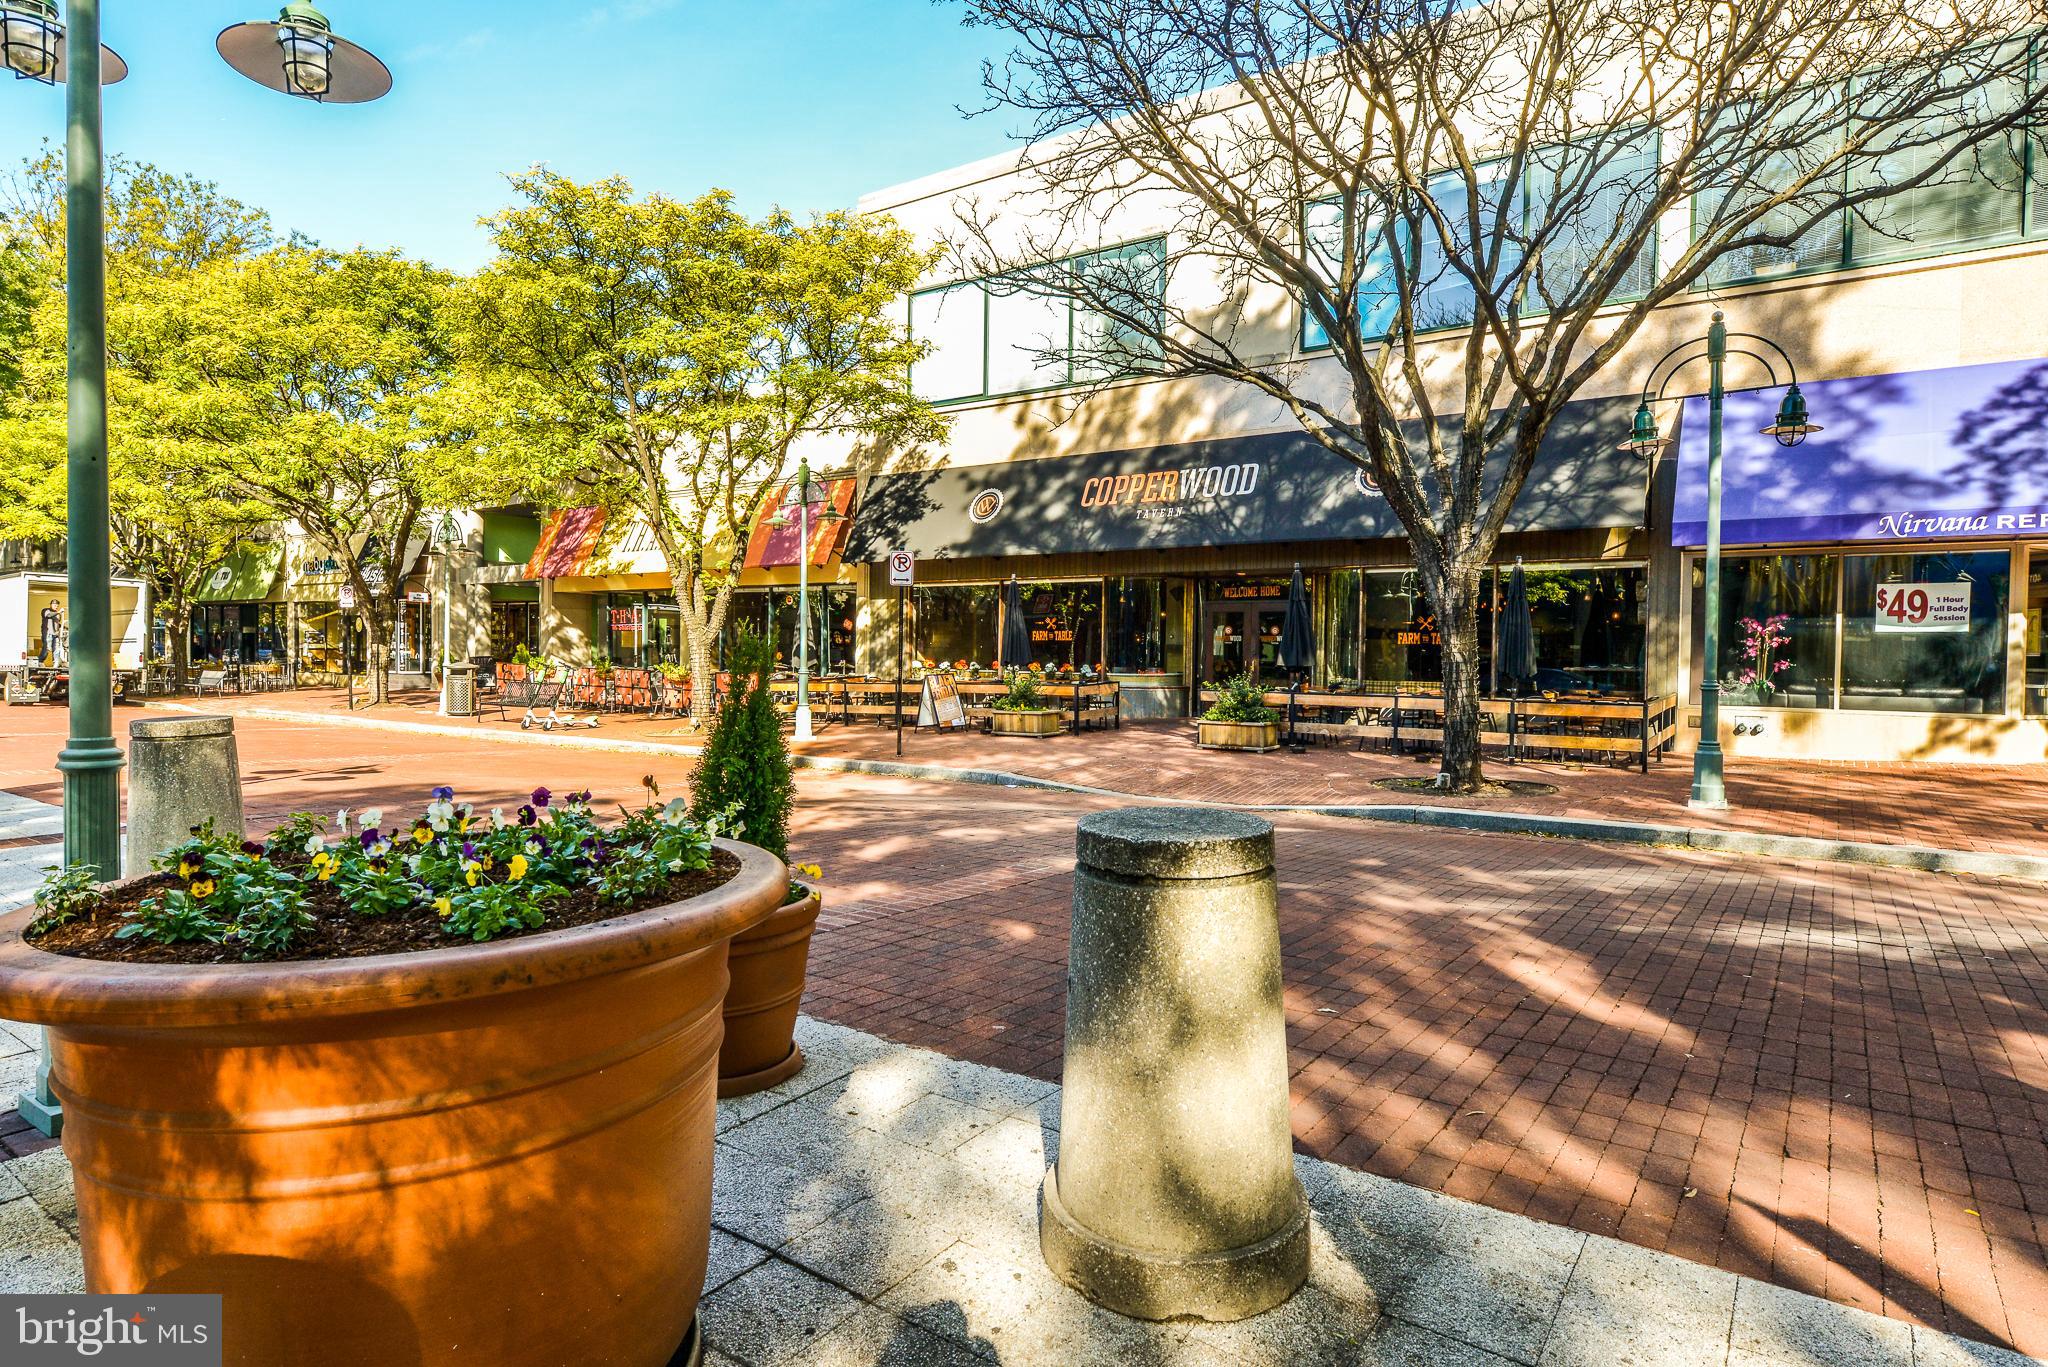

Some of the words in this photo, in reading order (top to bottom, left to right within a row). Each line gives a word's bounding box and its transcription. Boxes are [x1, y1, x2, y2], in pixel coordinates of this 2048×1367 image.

[1081, 463, 1260, 507] COPPERWOOD
[1136, 507, 1183, 519] TAVERN
[1877, 511, 1989, 537] Nirvana
[1223, 586, 1258, 598] WELCOME
[1260, 585, 1281, 597] HOME
[1877, 588, 1929, 624] $49
[1946, 605, 1969, 613] Body
[1032, 630, 1048, 641] FARM
[1054, 630, 1072, 641] TABLE
[1397, 632, 1421, 645] FARM
